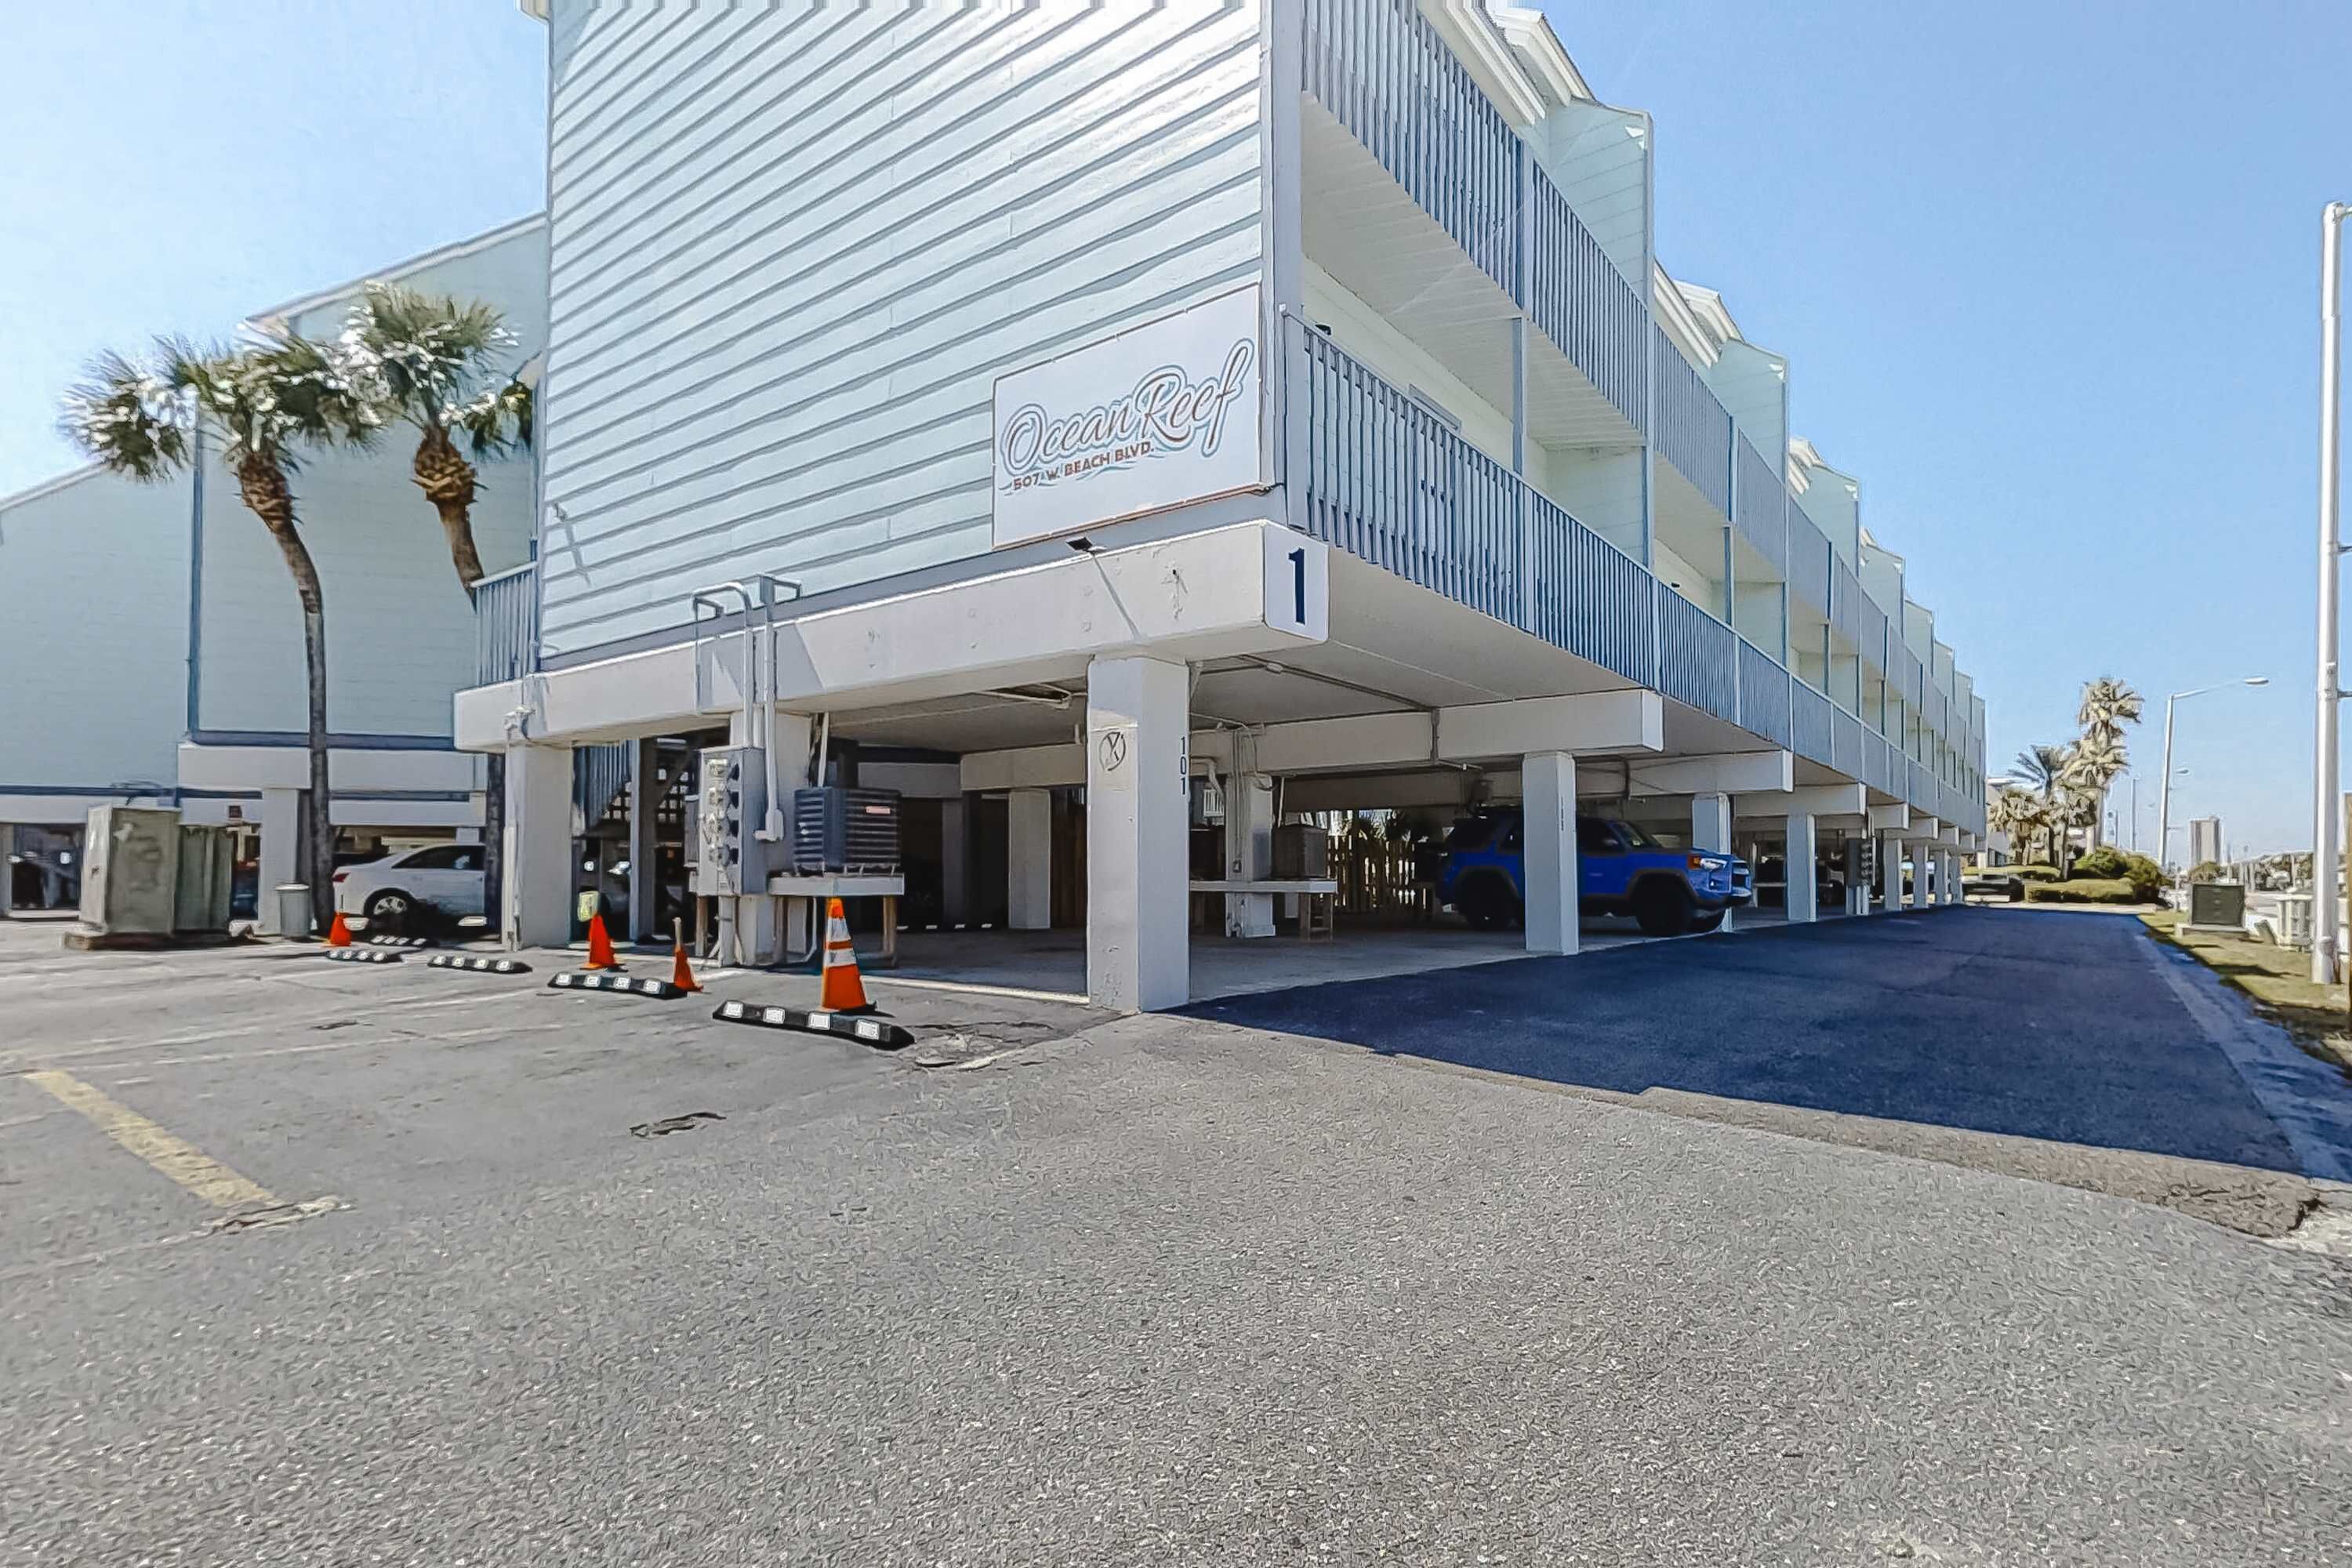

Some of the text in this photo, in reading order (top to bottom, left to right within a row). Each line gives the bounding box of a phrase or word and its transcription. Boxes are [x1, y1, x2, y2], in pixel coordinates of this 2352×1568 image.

[1007, 344, 1250, 472] Ocean Reef
[1013, 472, 1040, 491] 507
[1064, 452, 1110, 477] BEACH
[1115, 441, 1155, 463] BLVD.
[1288, 547, 1305, 625] 1
